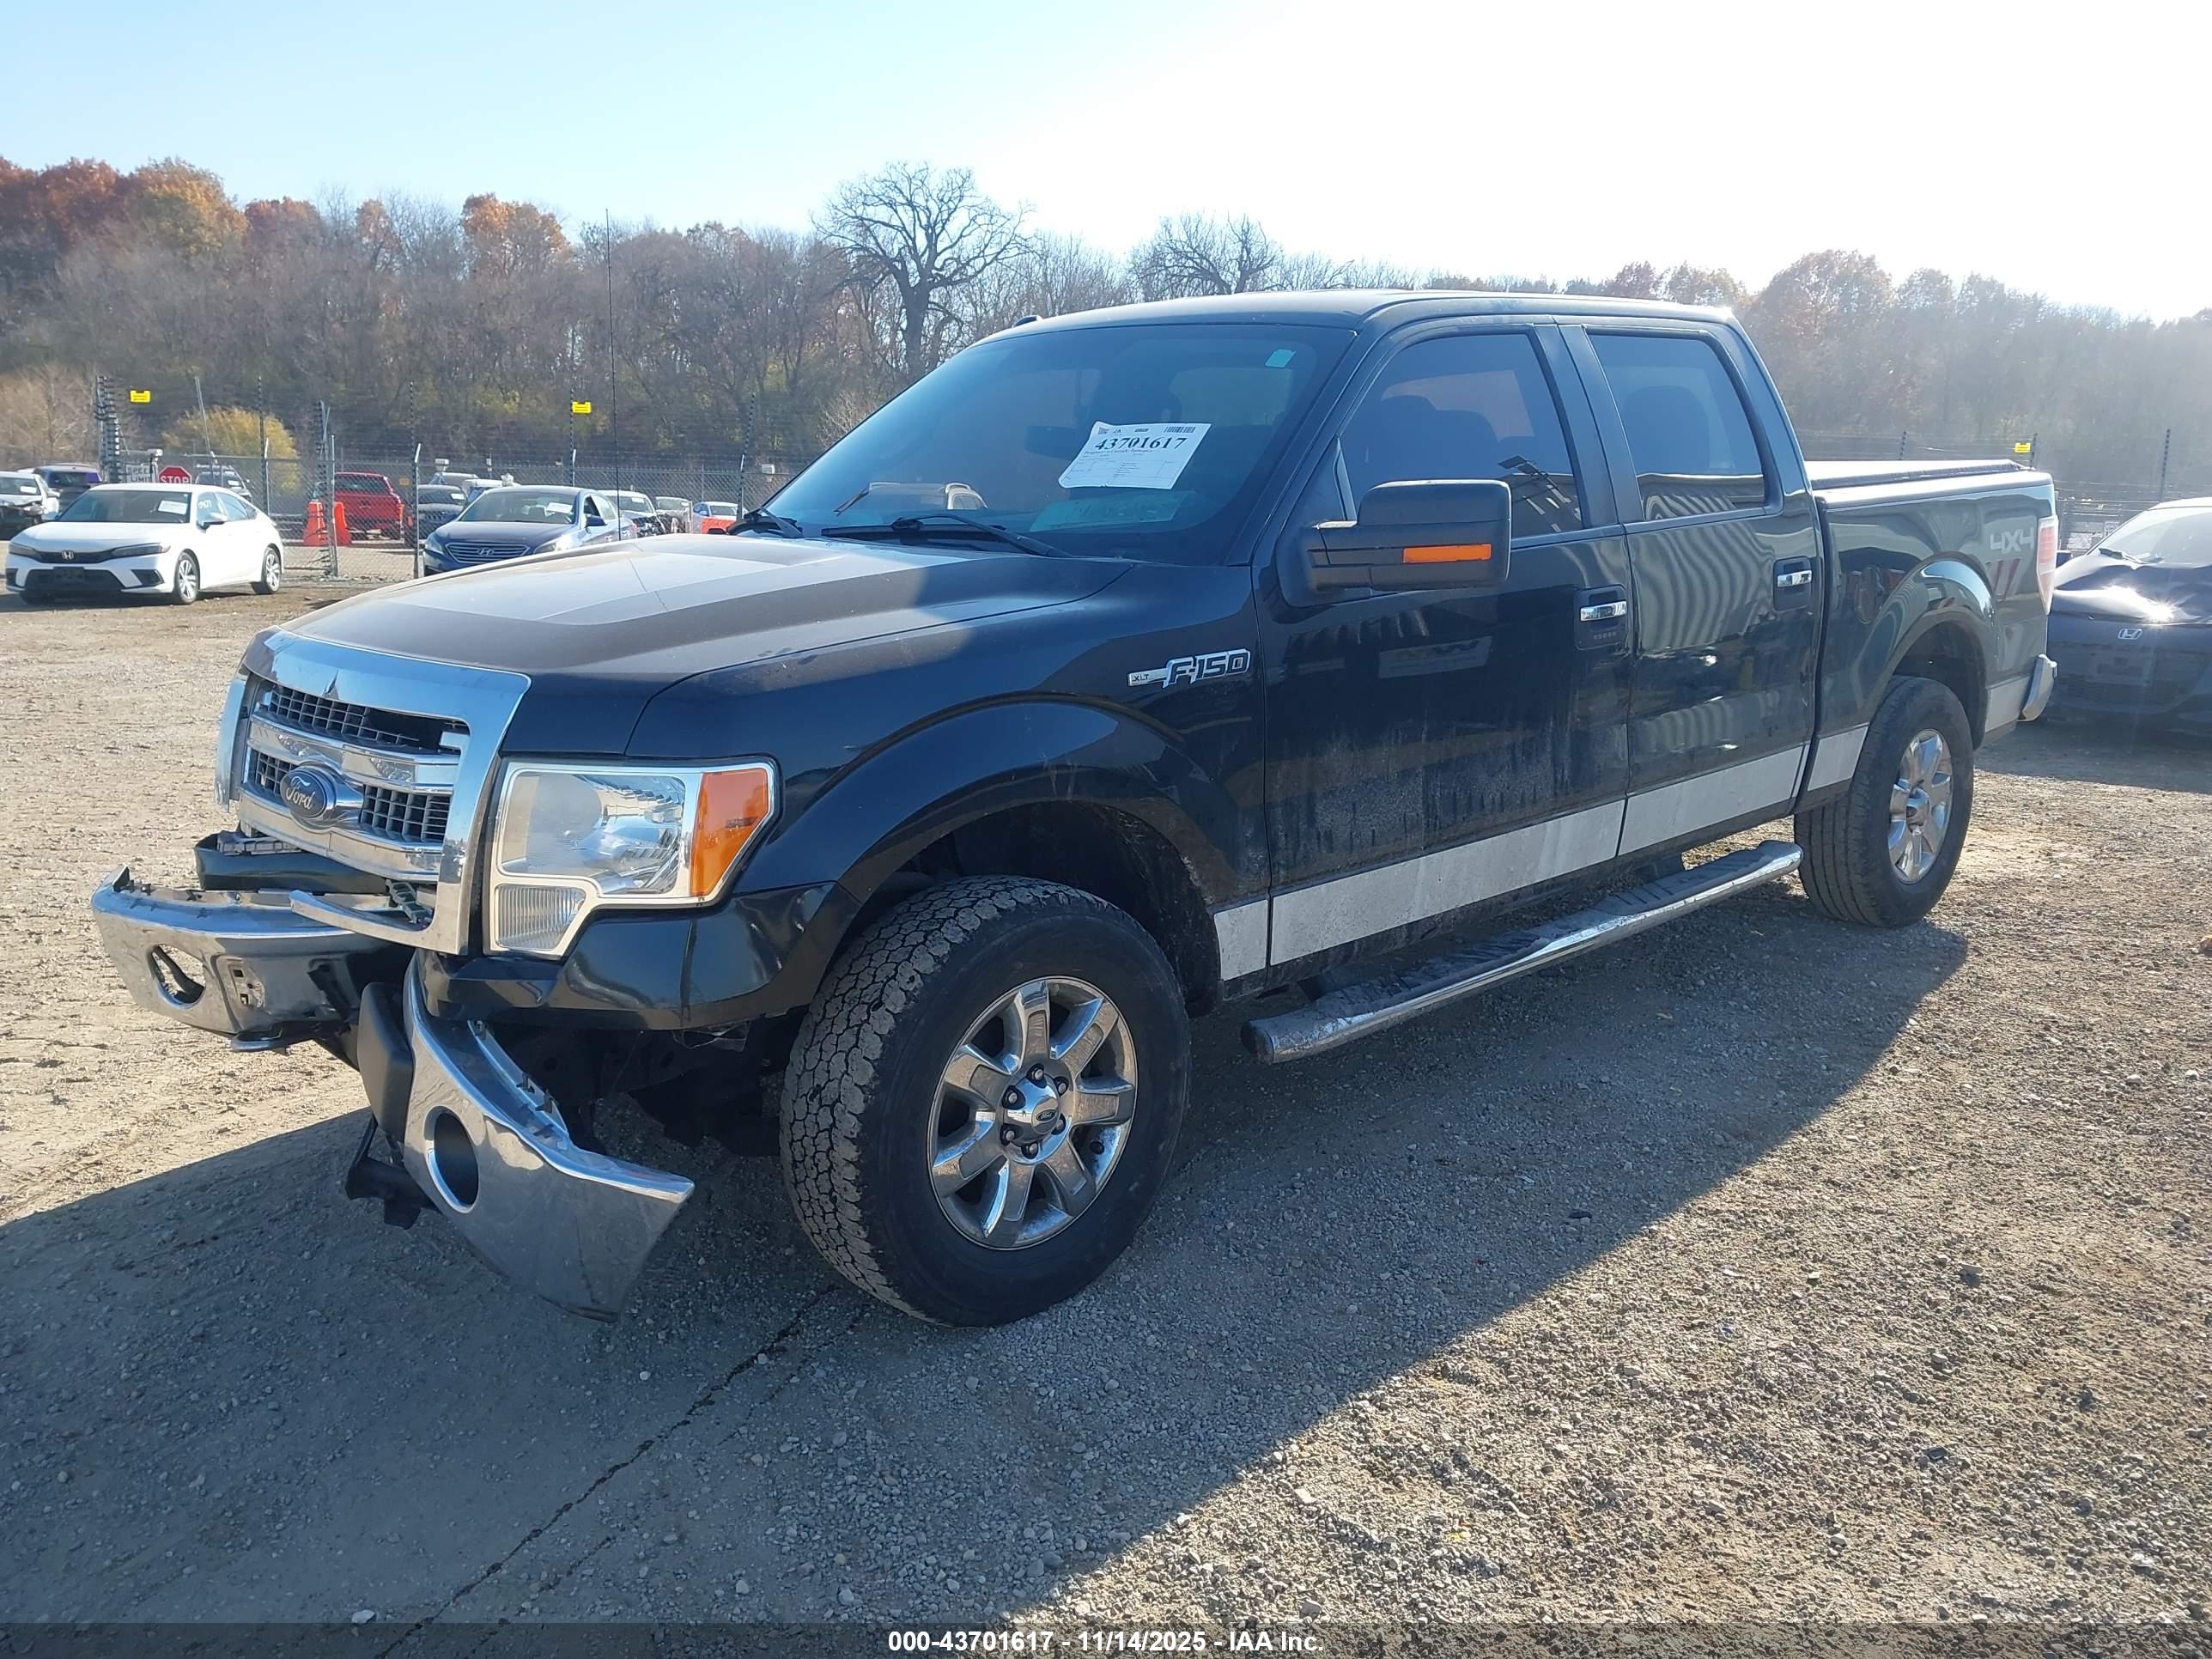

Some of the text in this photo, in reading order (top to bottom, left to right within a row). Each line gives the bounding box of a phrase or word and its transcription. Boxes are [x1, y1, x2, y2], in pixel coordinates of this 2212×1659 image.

[1095, 436, 1188, 450] 43701617
[160, 475, 190, 483] STOP
[1133, 648, 1252, 688] XLT F-150
[285, 776, 315, 810] Ford
